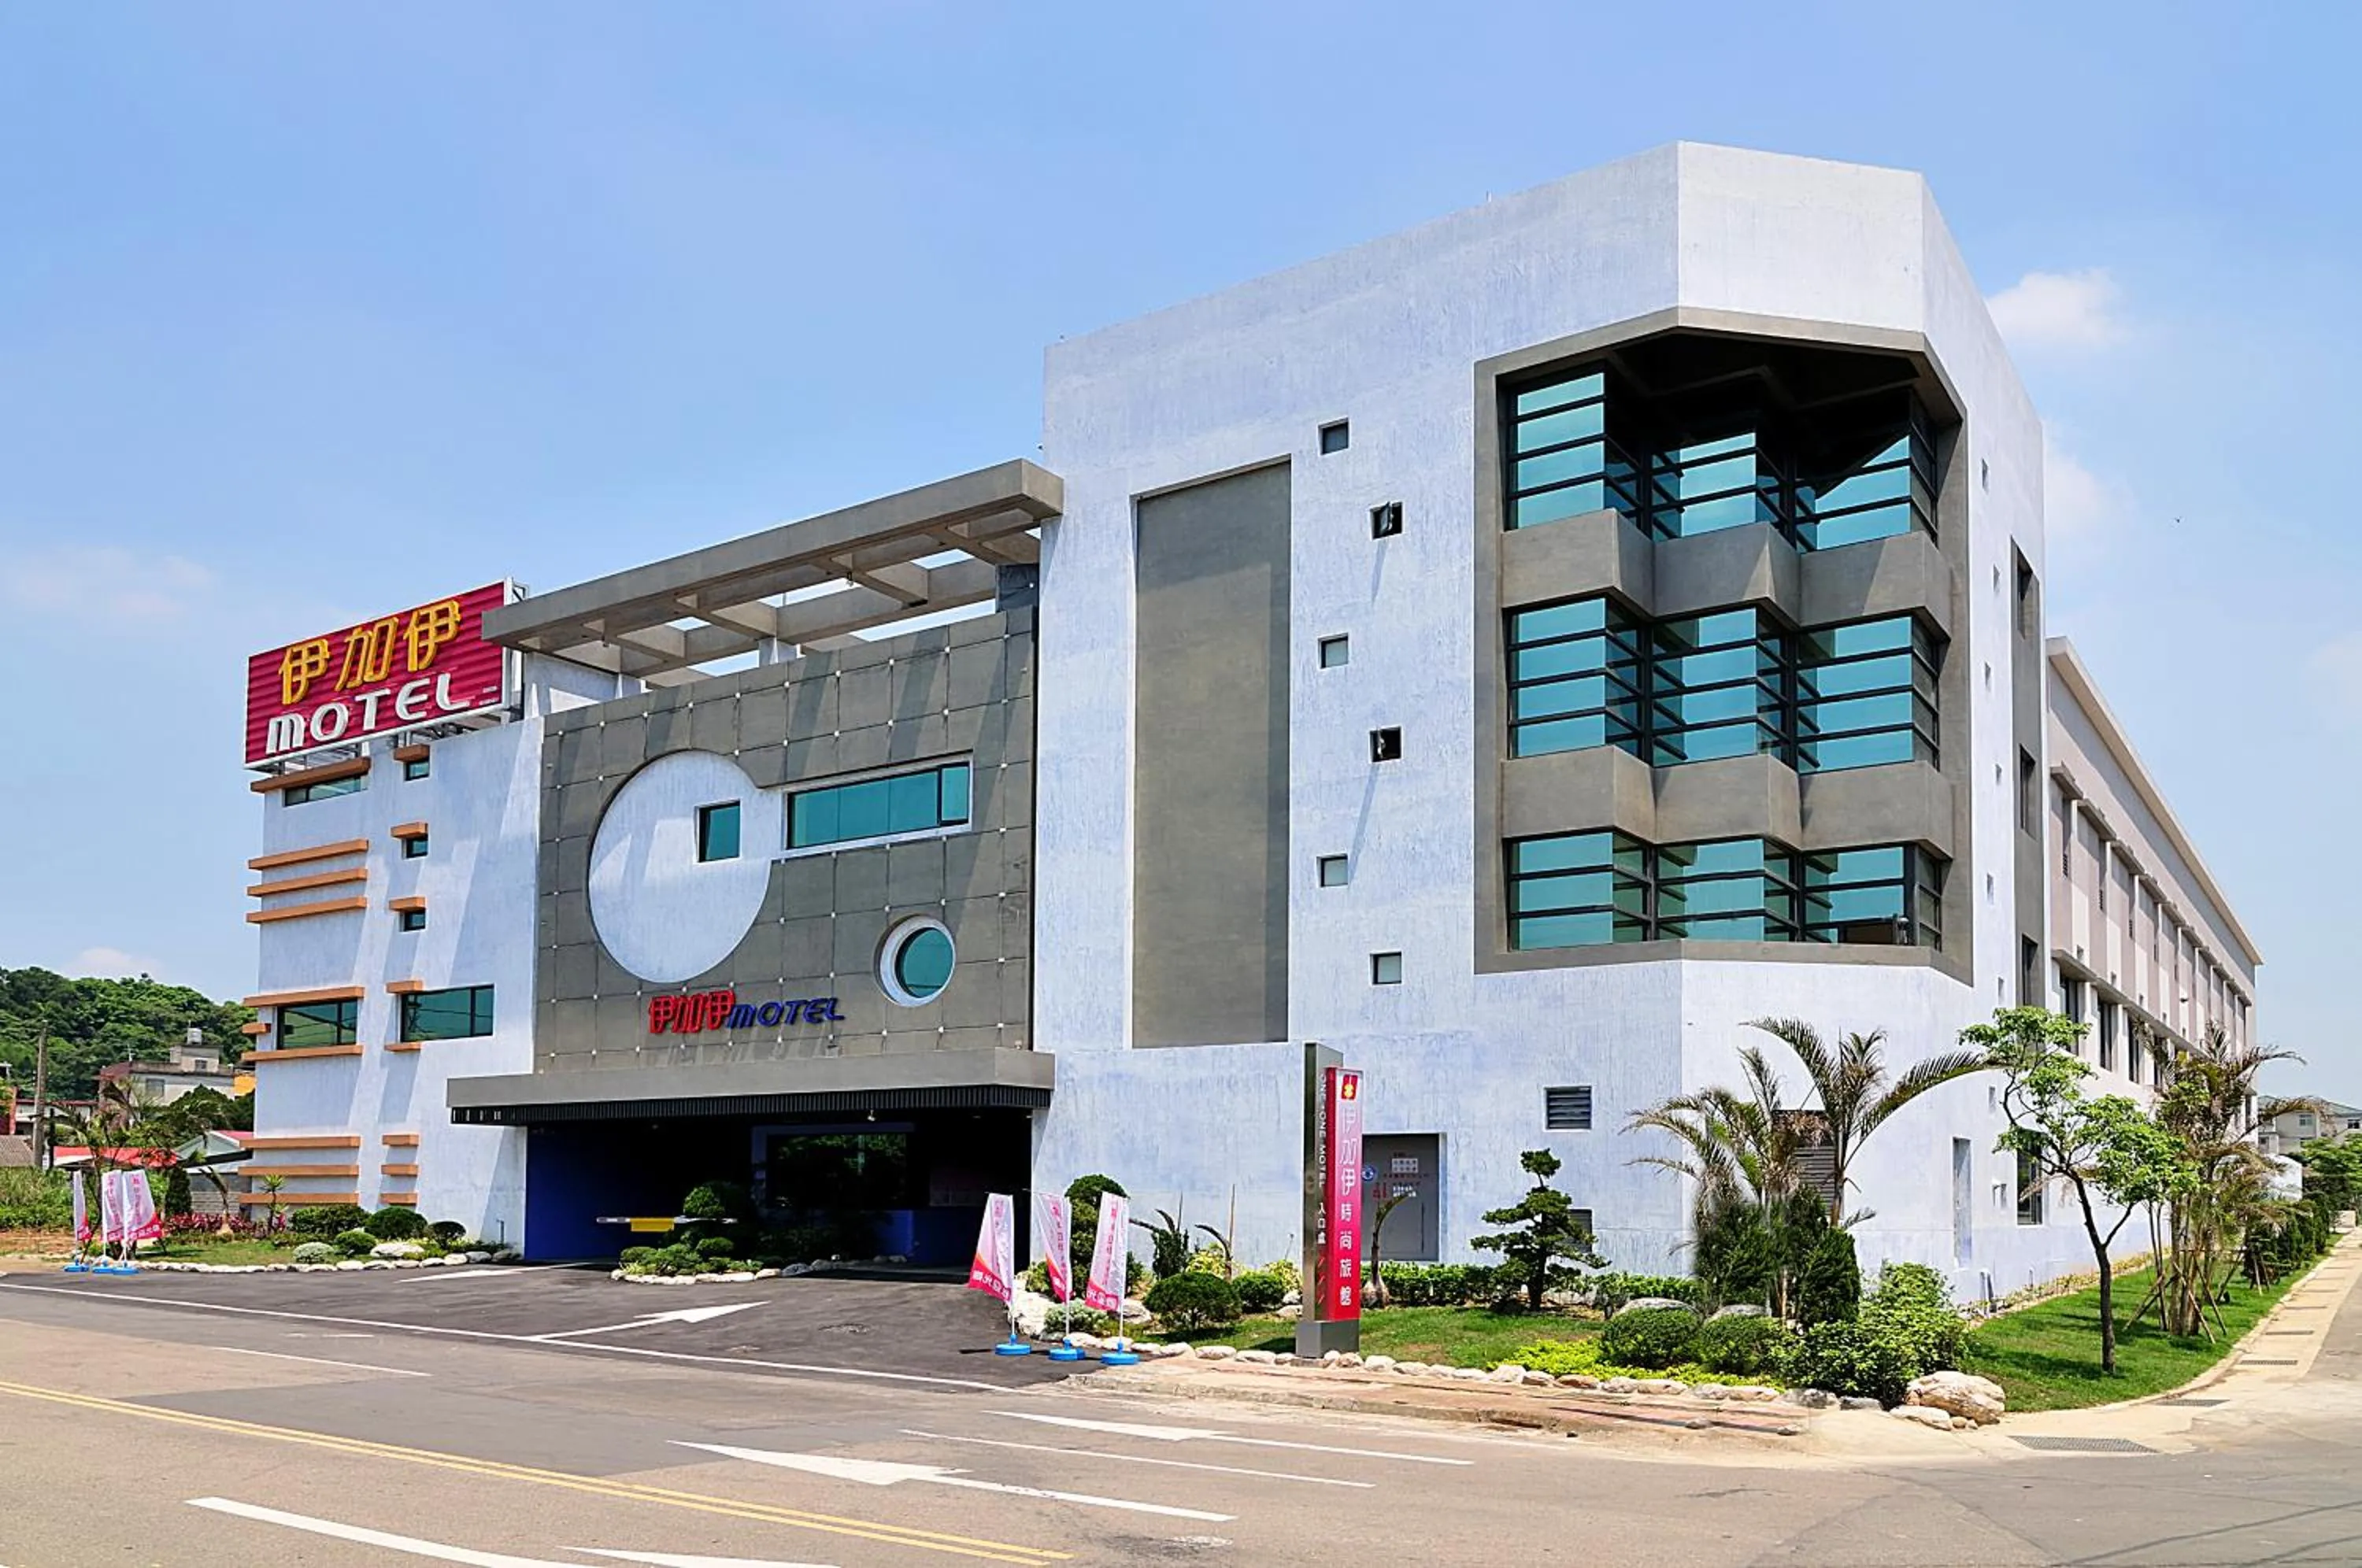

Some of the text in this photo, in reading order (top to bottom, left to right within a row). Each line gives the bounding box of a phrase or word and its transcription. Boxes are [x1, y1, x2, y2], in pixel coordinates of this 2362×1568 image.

[279, 600, 461, 705] 伊加伊
[649, 989, 737, 1034] 伊加伊
